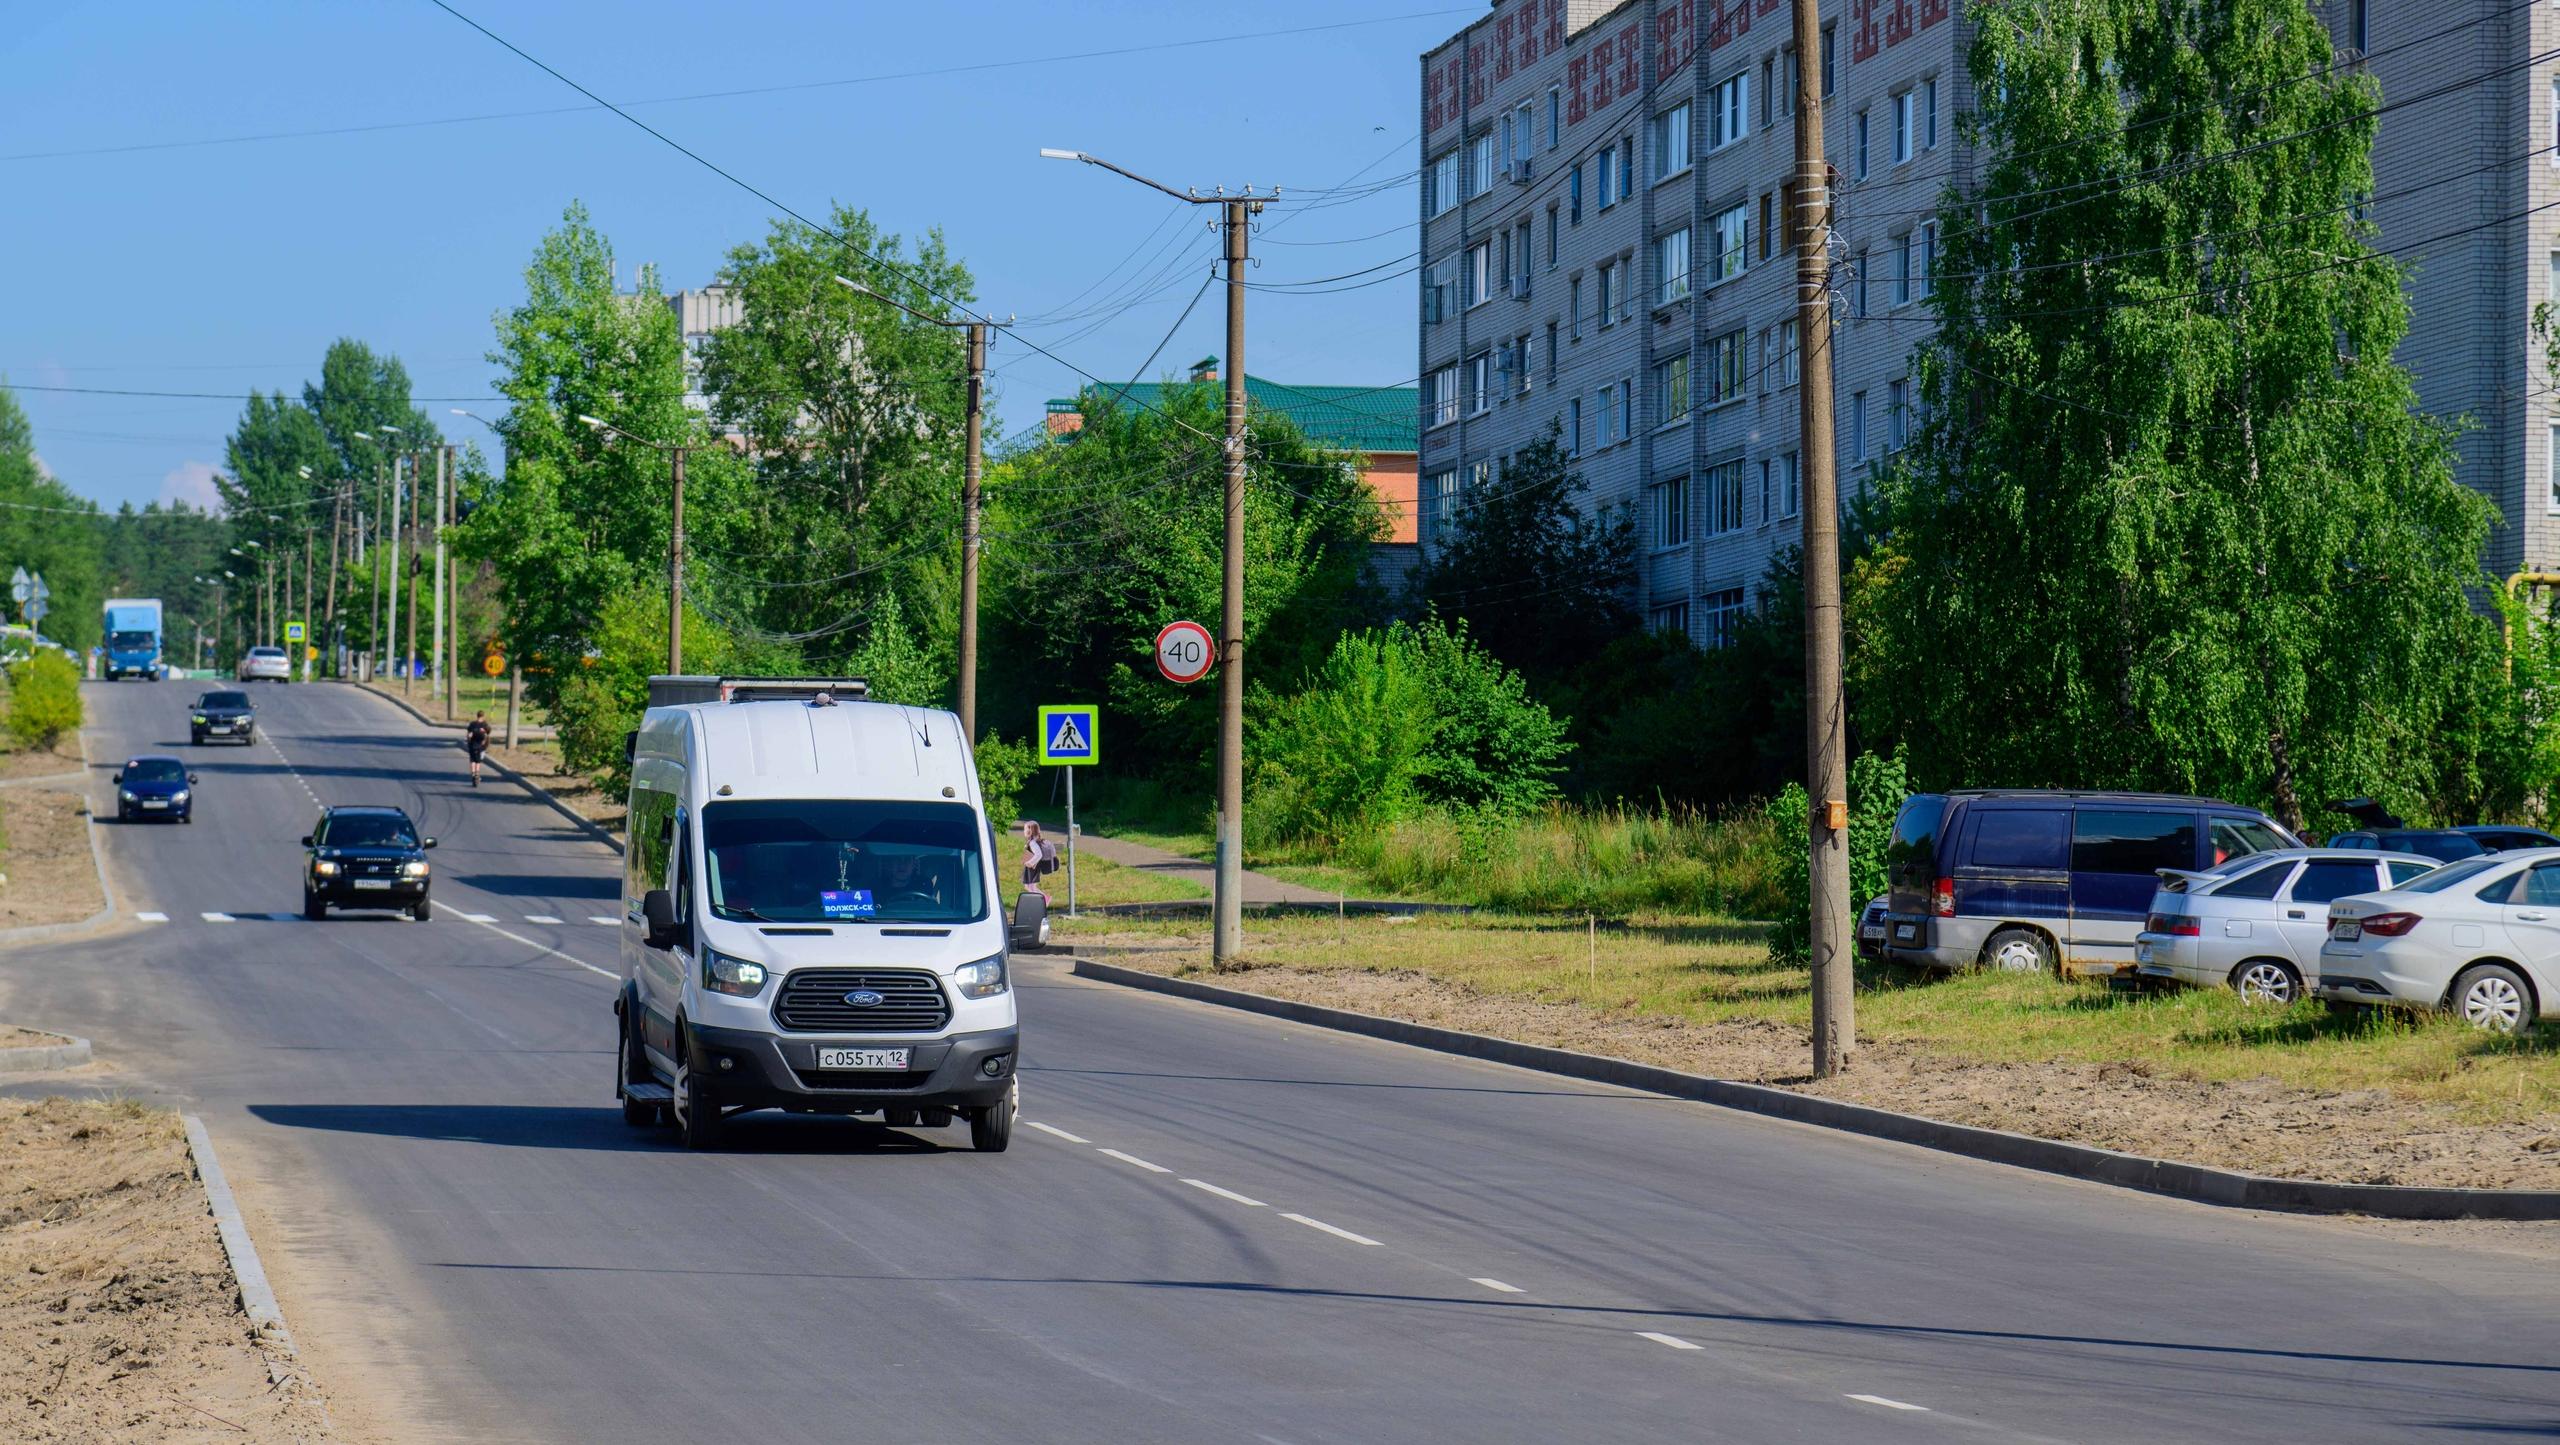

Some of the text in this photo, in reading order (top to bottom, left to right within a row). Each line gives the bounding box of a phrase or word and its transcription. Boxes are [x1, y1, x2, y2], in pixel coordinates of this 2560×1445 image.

[1168, 641, 1200, 663] 40
[853, 890, 862, 901] 4
[824, 904, 874, 912] ВОЛЖСК-СК
[853, 993, 875, 1004] Ford
[888, 1051, 903, 1062] 12
